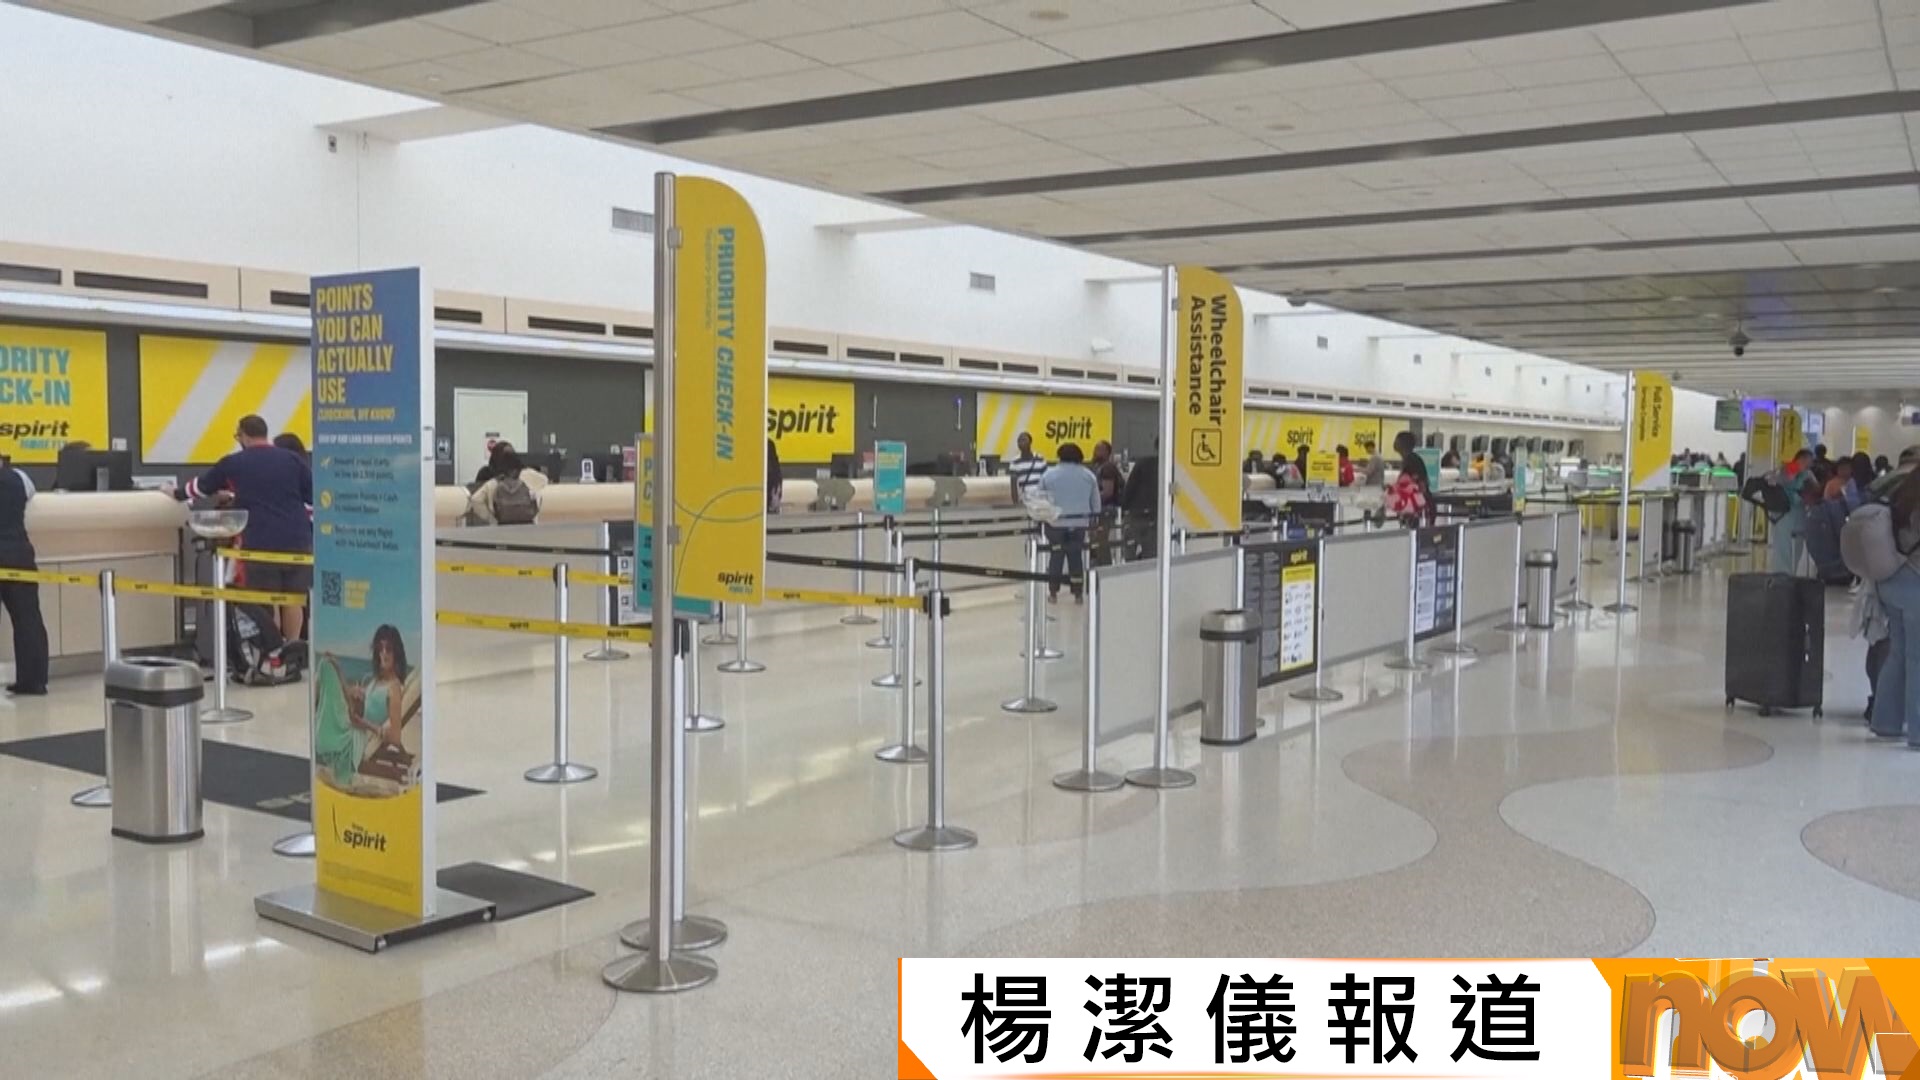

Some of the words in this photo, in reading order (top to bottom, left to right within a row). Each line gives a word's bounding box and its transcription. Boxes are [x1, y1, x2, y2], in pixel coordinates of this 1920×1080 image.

[717, 227, 735, 339] PRIORITY
[316, 283, 373, 314] POINTS
[317, 316, 347, 343] YOU
[351, 314, 383, 341] CAN
[317, 345, 394, 373] ACTUALLY
[1189, 296, 1207, 416] Assistance
[1210, 294, 1227, 426] Wheelchair
[318, 377, 346, 404] USE
[716, 346, 735, 461] CHECK-IN
[0, 420, 70, 440] spirit
[767, 403, 838, 439] spirit
[1045, 416, 1092, 443] spirit
[1287, 427, 1314, 447] spirit
[718, 570, 754, 586] spirit
[343, 828, 387, 852] spirit
